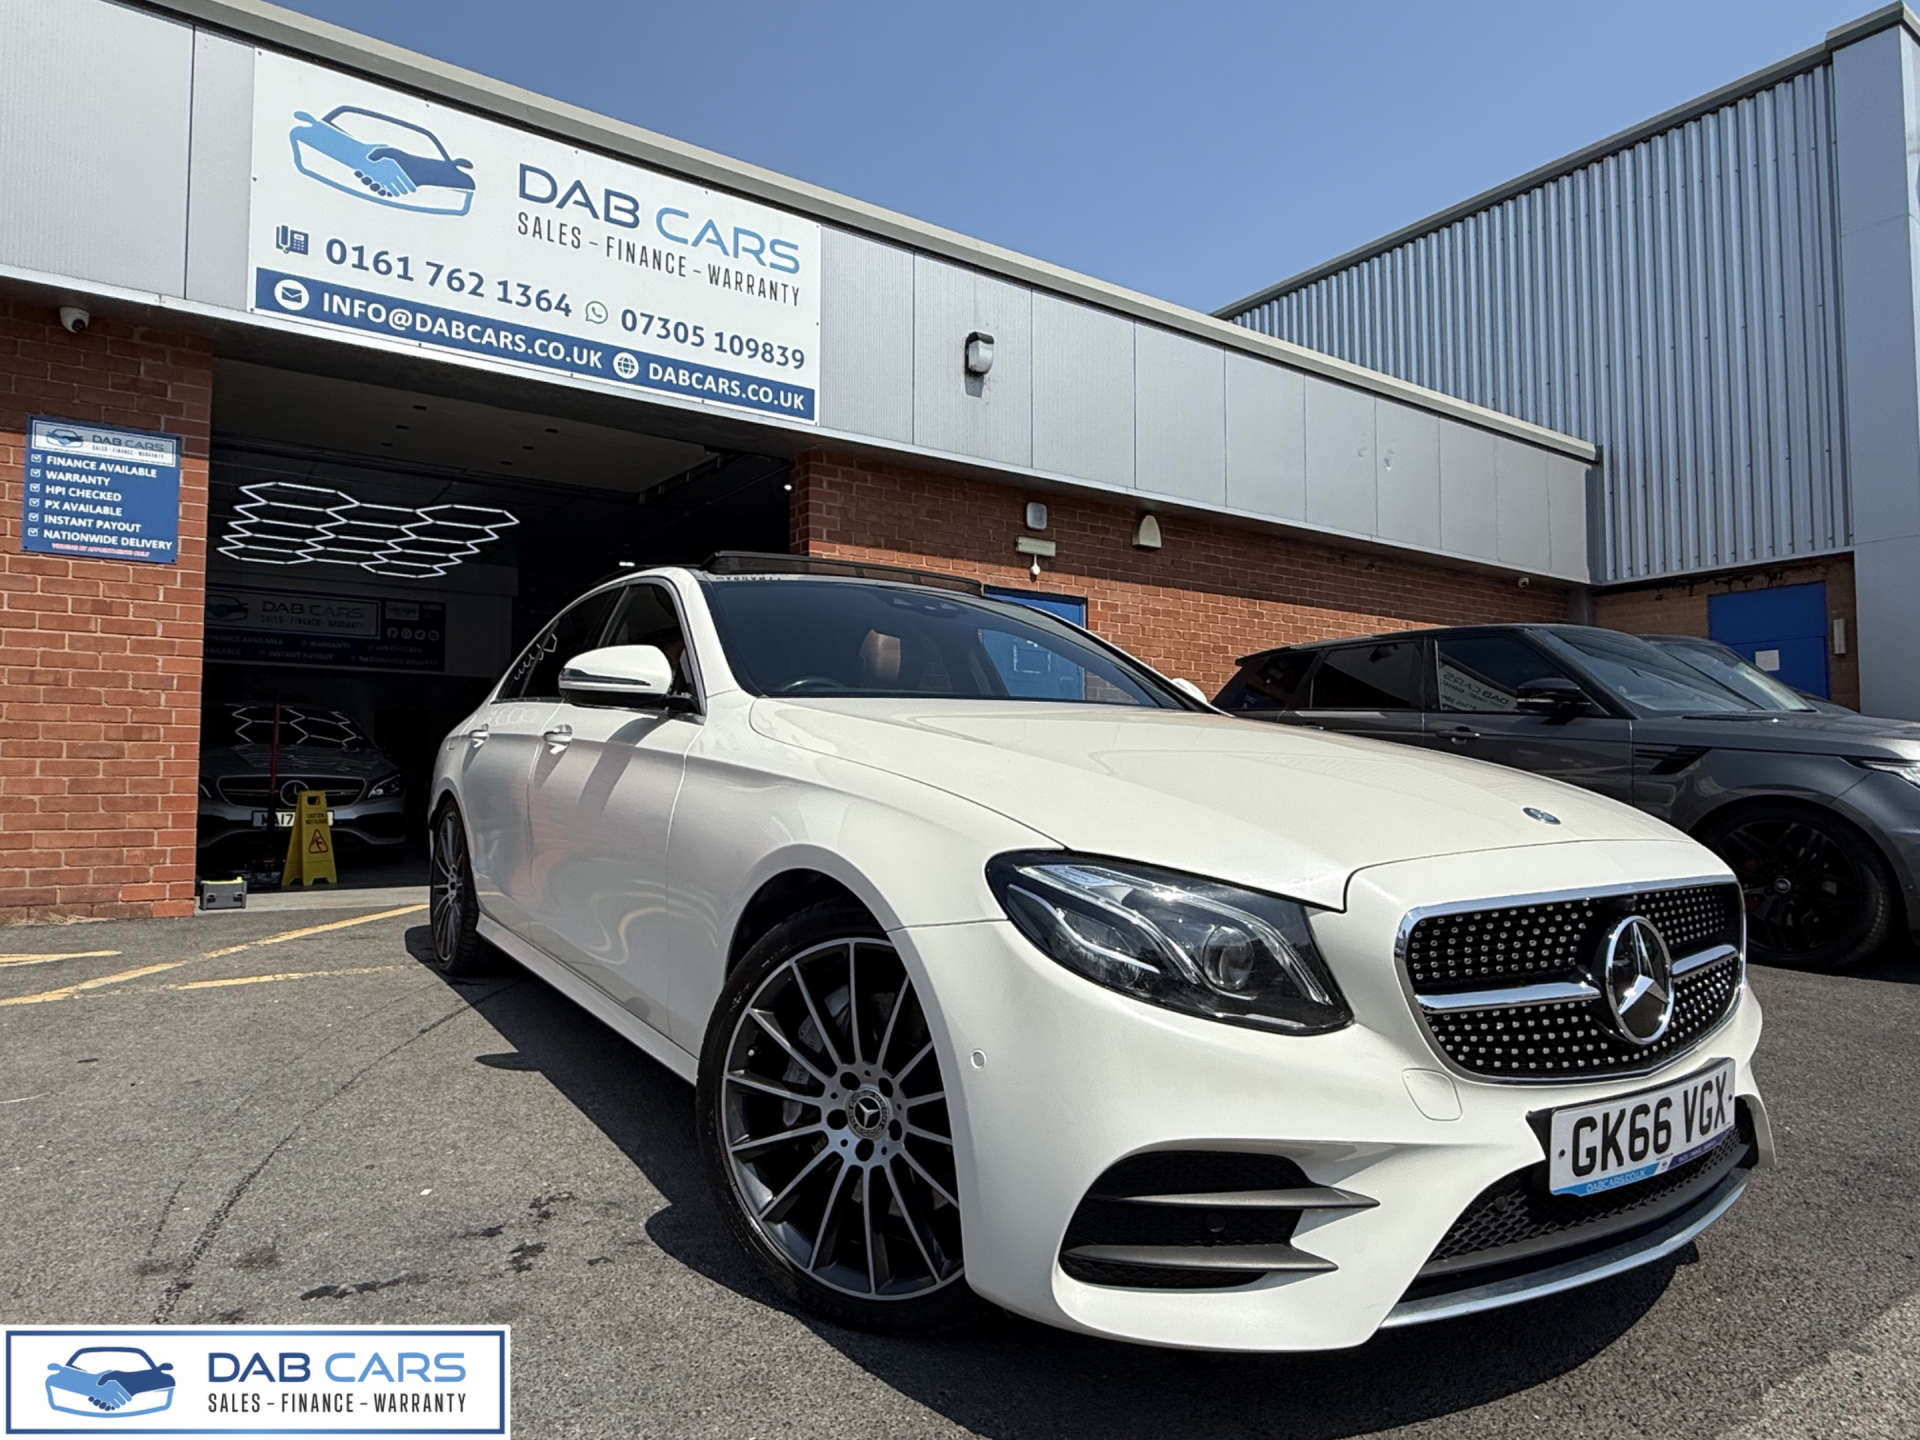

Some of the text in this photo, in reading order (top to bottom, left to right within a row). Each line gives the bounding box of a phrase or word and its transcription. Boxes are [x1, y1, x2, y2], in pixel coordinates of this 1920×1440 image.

[518, 163, 801, 275] DAB CARS
[517, 211, 582, 249] SALES
[606, 235, 686, 277] FINANCE
[708, 263, 801, 307] WARRANTY
[326, 238, 573, 317] 0161 762 1364
[321, 291, 603, 369] INFO@DABCARS.CO.UK
[621, 309, 805, 370] 07305 109839
[648, 362, 805, 411] DABCARS.CO.UK
[92, 434, 165, 452] DAB CARS
[46, 456, 158, 478] FINANCE AVAILABLE
[46, 470, 110, 486] WARRANTY
[46, 485, 122, 501] HPI CHECKED
[45, 500, 123, 516] PX AVAILABLE
[44, 514, 141, 532] INSTANT PAYOUT
[43, 529, 173, 550] NATIONWIDE DELIVERY
[262, 600, 363, 619] DAB CARS
[1572, 1071, 1728, 1177] GK66 VGX
